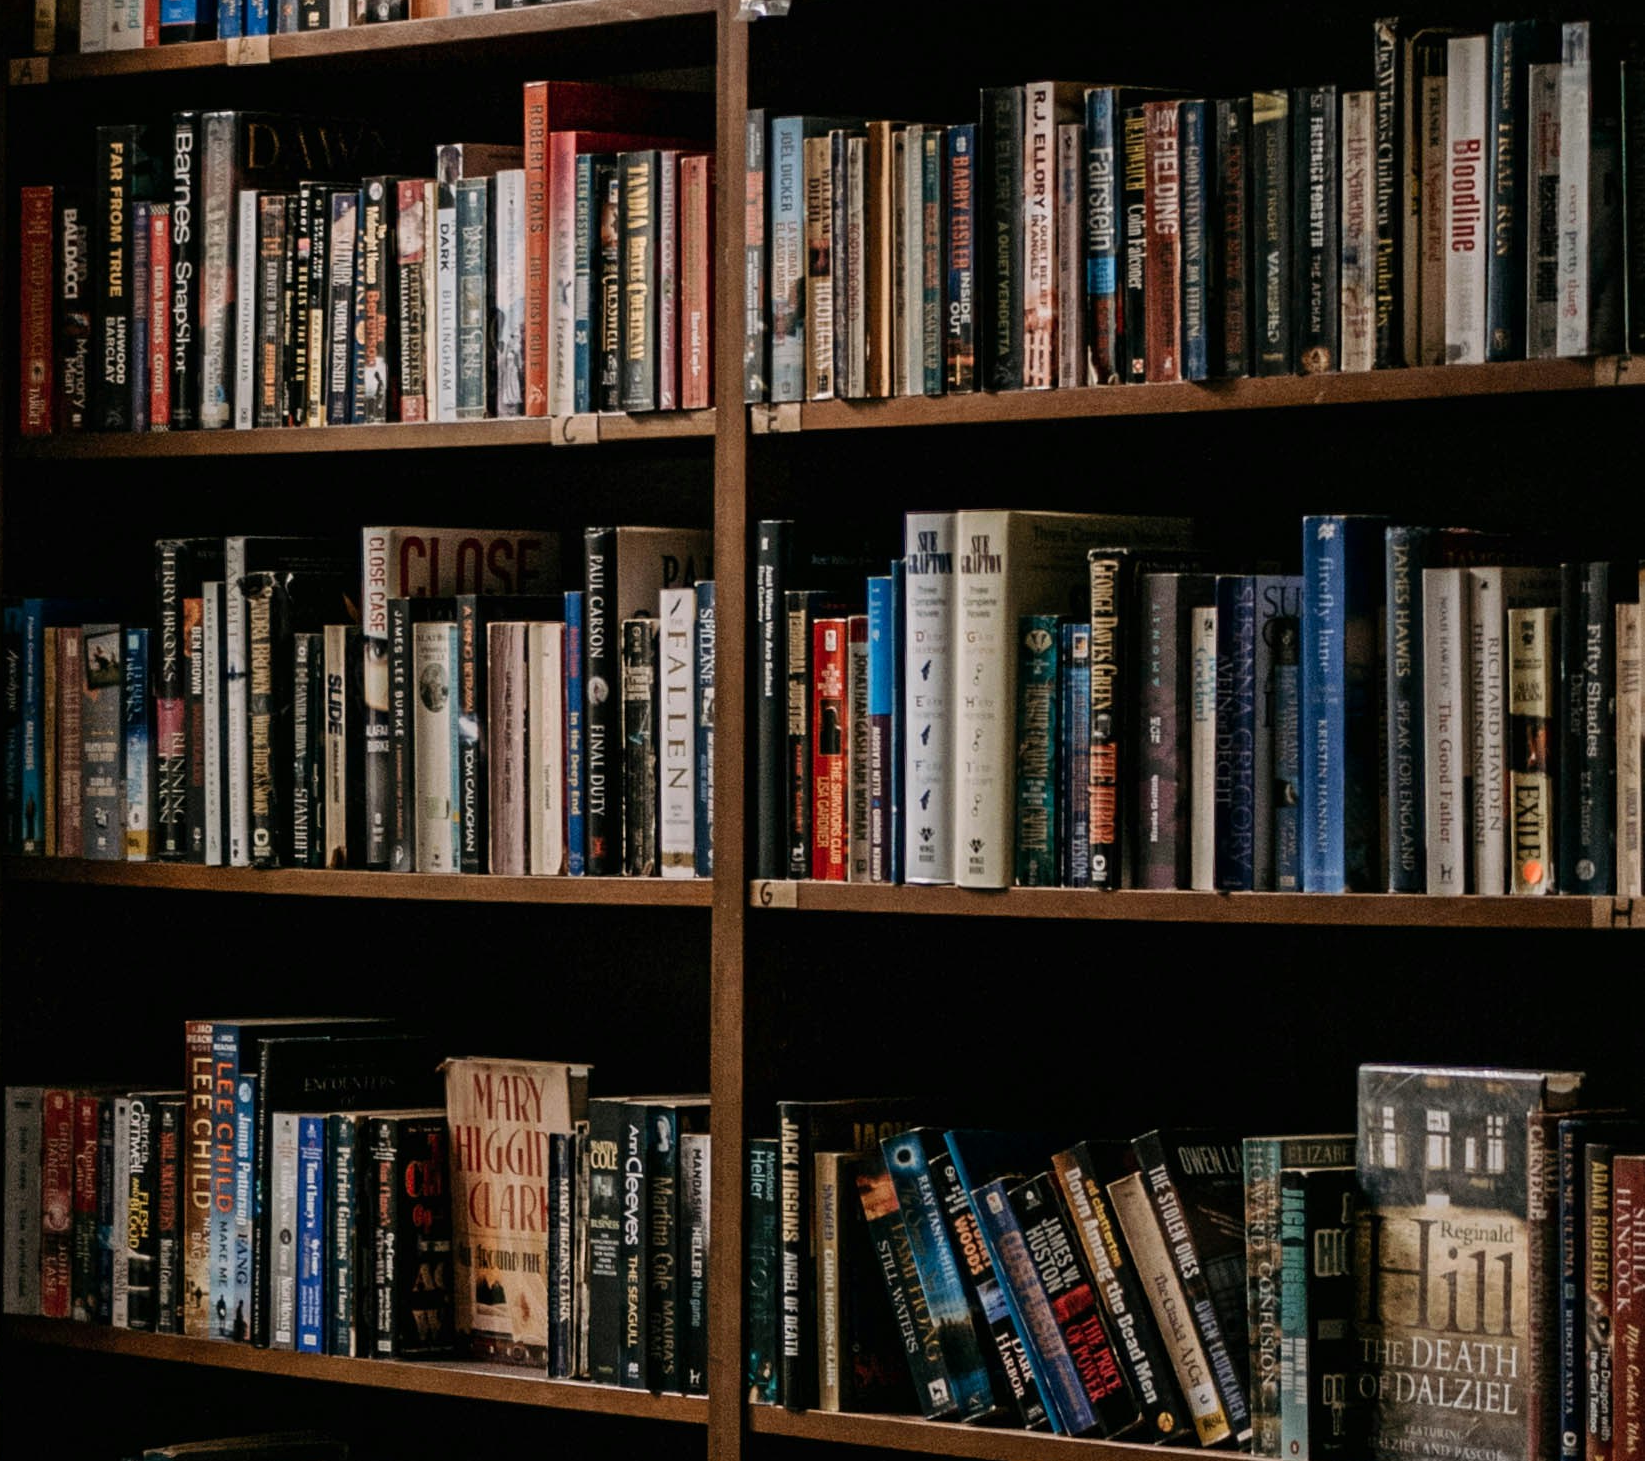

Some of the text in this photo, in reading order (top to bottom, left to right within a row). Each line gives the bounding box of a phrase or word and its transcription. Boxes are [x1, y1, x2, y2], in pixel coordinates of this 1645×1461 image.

[530, 104, 544, 233] ROBERT CRAIS
[781, 164, 793, 212] DICKER
[1034, 134, 1045, 208] ELLORY
[1088, 147, 1113, 252] Fairstein
[1154, 137, 1178, 235] FIELDING
[1452, 139, 1481, 252] Bloodline
[1495, 121, 1513, 257] TRIAL RUN
[63, 208, 78, 299] BALDACCI
[109, 142, 124, 297] FAR FROM TRUE
[173, 133, 193, 372] Barnes SnapShot
[440, 223, 450, 271] DARK
[441, 290, 453, 391] BILLINGHAM
[950, 302, 960, 335] OUT
[961, 271, 971, 324] INSIDE
[104, 317, 115, 384] BARCLAY
[115, 316, 126, 384] LINWOOD
[562, 416, 576, 442] C
[369, 537, 385, 631] CLOSE CASE
[191, 626, 202, 695] BEN BROWN
[328, 674, 342, 736] SLIDE
[394, 611, 405, 737] JAMES LEE BURKE
[589, 554, 605, 816] PAUL CARSON FINAL DUTY
[667, 631, 688, 789] FALLEN
[1393, 544, 1416, 871] JAMES HAWES SPEAK FOR ENGLAND
[1584, 624, 1601, 758] Fifty Shades
[464, 749, 476, 852] TOM CALLAGHAN
[1439, 700, 1453, 843] The Good Father
[1516, 785, 1540, 859] EXILE
[760, 882, 772, 906] G
[1611, 899, 1633, 929] H
[130, 1101, 144, 1173] Cornwell
[193, 1056, 212, 1209] LEE CHILD
[215, 1060, 234, 1287] LEE CHILD MAKE ME
[749, 1150, 765, 1199] Heller
[624, 1124, 642, 1348] Ann Cleeves THE SEAGULL
[782, 1118, 800, 1357] JACK HIGGINS ANGEL OF DEATH
[954, 1214, 984, 1276] WOODS
[1025, 1225, 1064, 1294] HUSTON
[1148, 1164, 1199, 1280] THE STOLEN ONES
[1440, 1220, 1515, 1246] Reginald
[1591, 1161, 1609, 1292] ADAM ROBERTS
[689, 1227, 702, 1327] HELLER the game
[1065, 1168, 1158, 1404] Down Among the Dead Men
[1258, 1260, 1276, 1387] CONFUSION
[1360, 1217, 1515, 1338] Hill
[994, 1332, 1025, 1399] HARBOR
[1358, 1373, 1518, 1415] OF DALZIEL
[1360, 1337, 1519, 1378] THE DEATH
